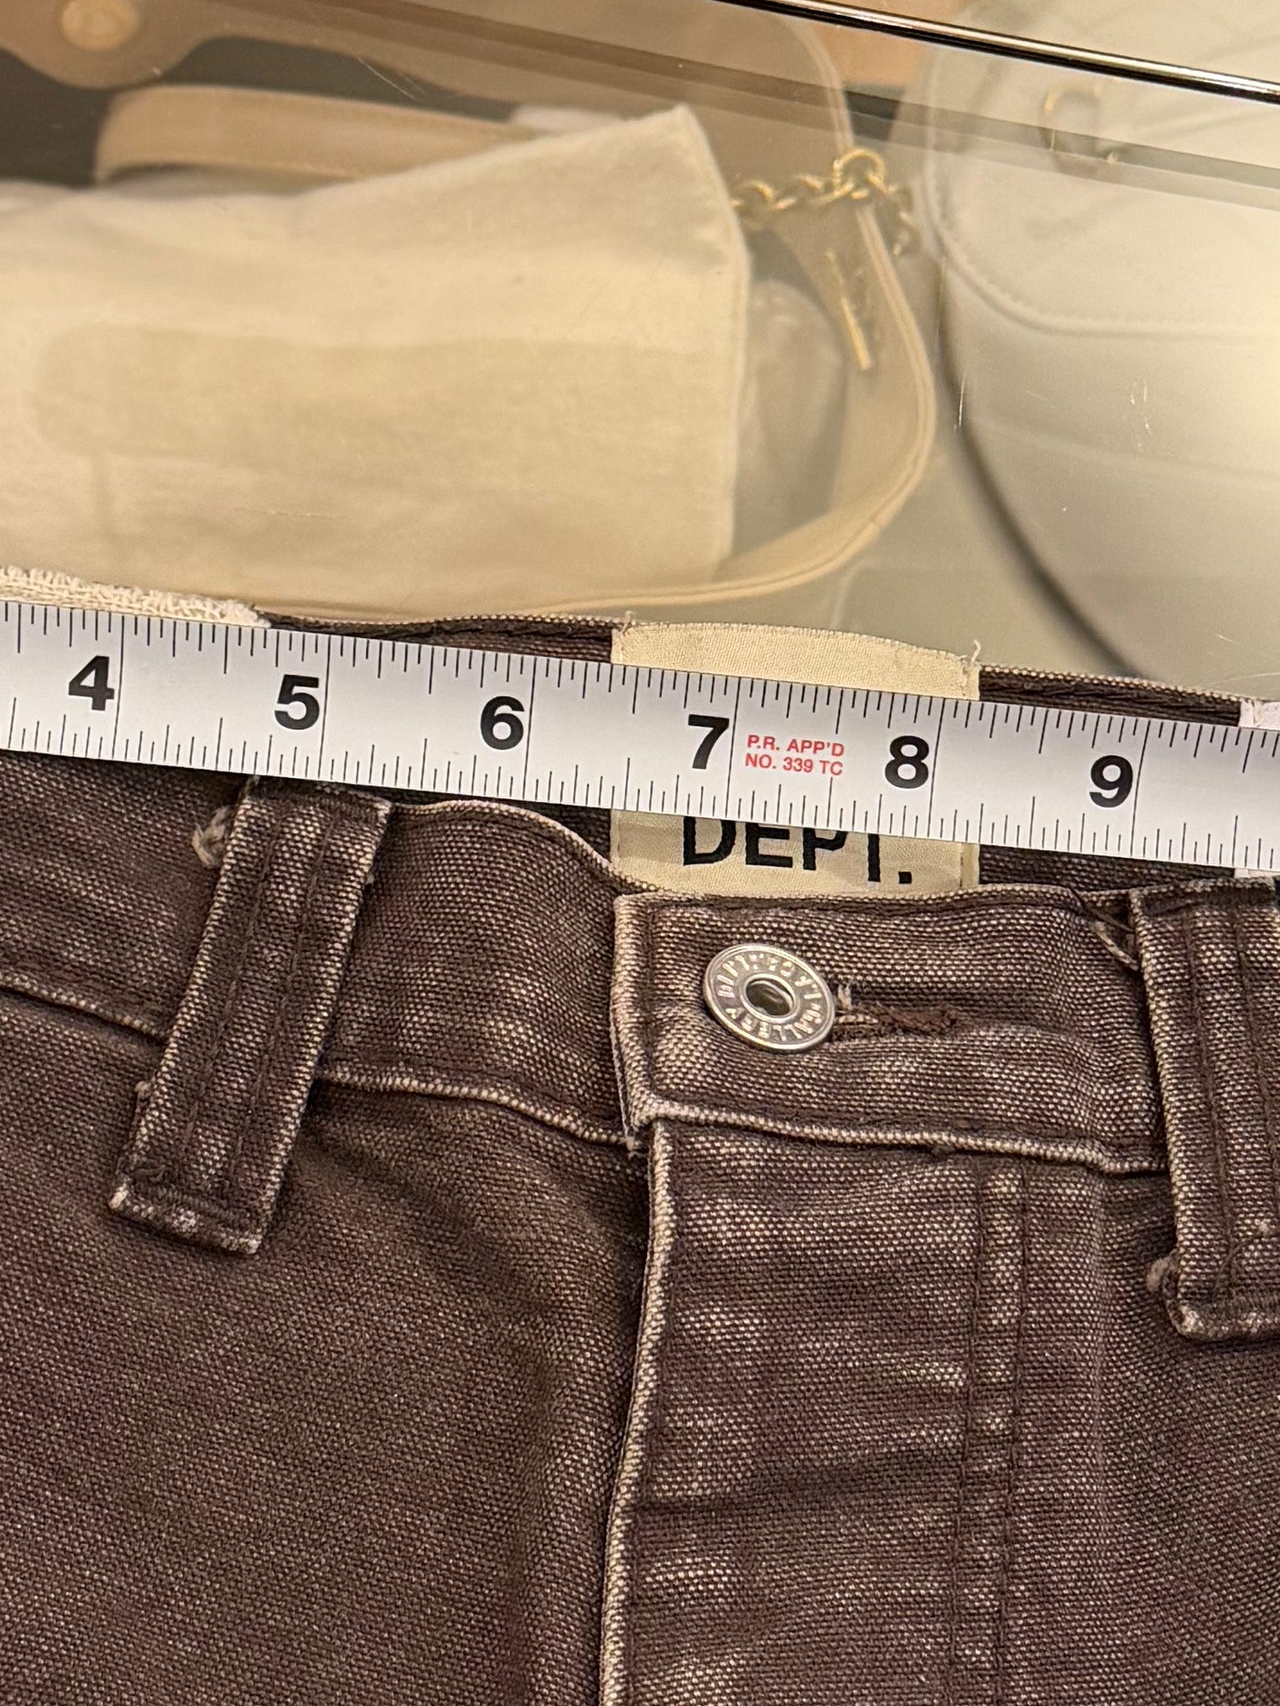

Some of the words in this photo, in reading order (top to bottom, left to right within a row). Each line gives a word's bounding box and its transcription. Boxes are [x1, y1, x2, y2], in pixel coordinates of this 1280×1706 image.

[68, 655, 116, 711] 4
[274, 674, 320, 730] 5
[479, 696, 526, 750] 6
[687, 714, 730, 770] 7
[747, 734, 780, 751] P.R.
[786, 737, 845, 758] APP'D
[745, 754, 777, 771] NO.
[782, 757, 814, 775] 339
[818, 759, 843, 777] TC
[885, 735, 930, 789] 8
[1089, 755, 1134, 809] 9
